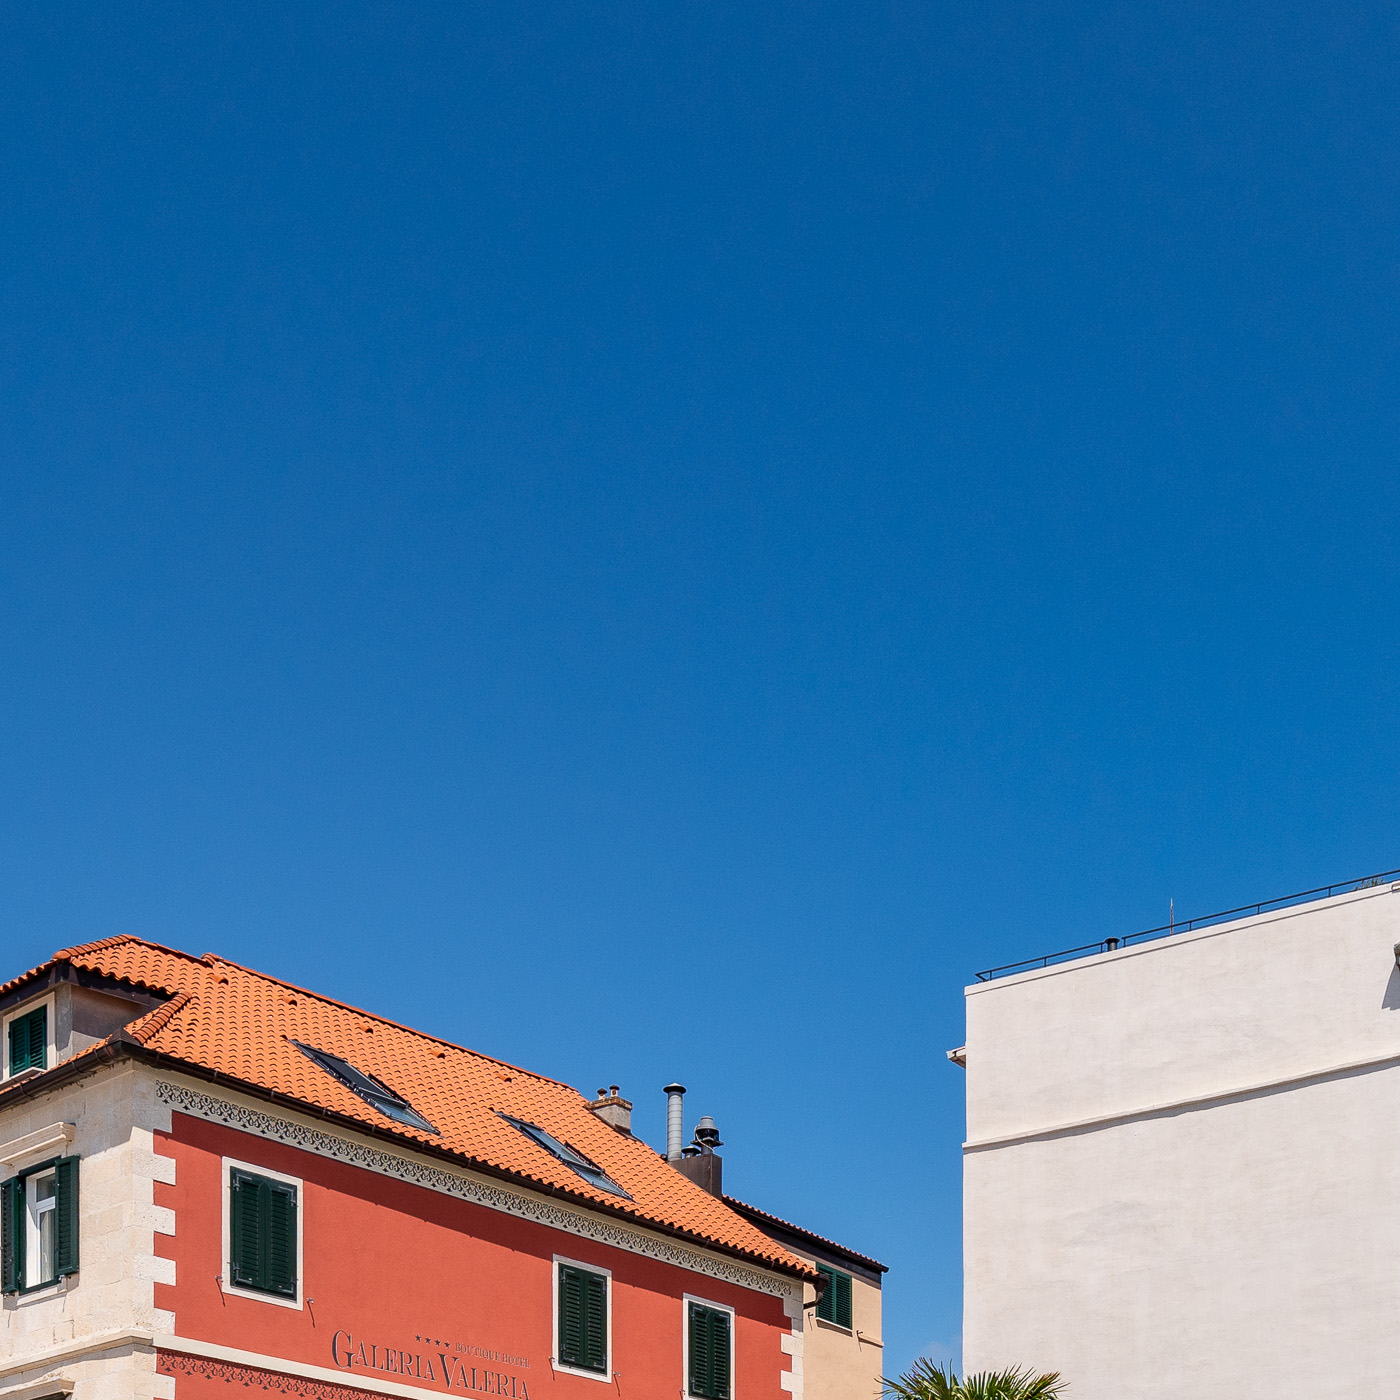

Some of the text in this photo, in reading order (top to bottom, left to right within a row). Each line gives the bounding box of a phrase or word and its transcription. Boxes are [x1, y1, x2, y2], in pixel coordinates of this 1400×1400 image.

[331, 1330, 436, 1382] GALERIA
[455, 1342, 531, 1369] BOUTIQUE HOTEL
